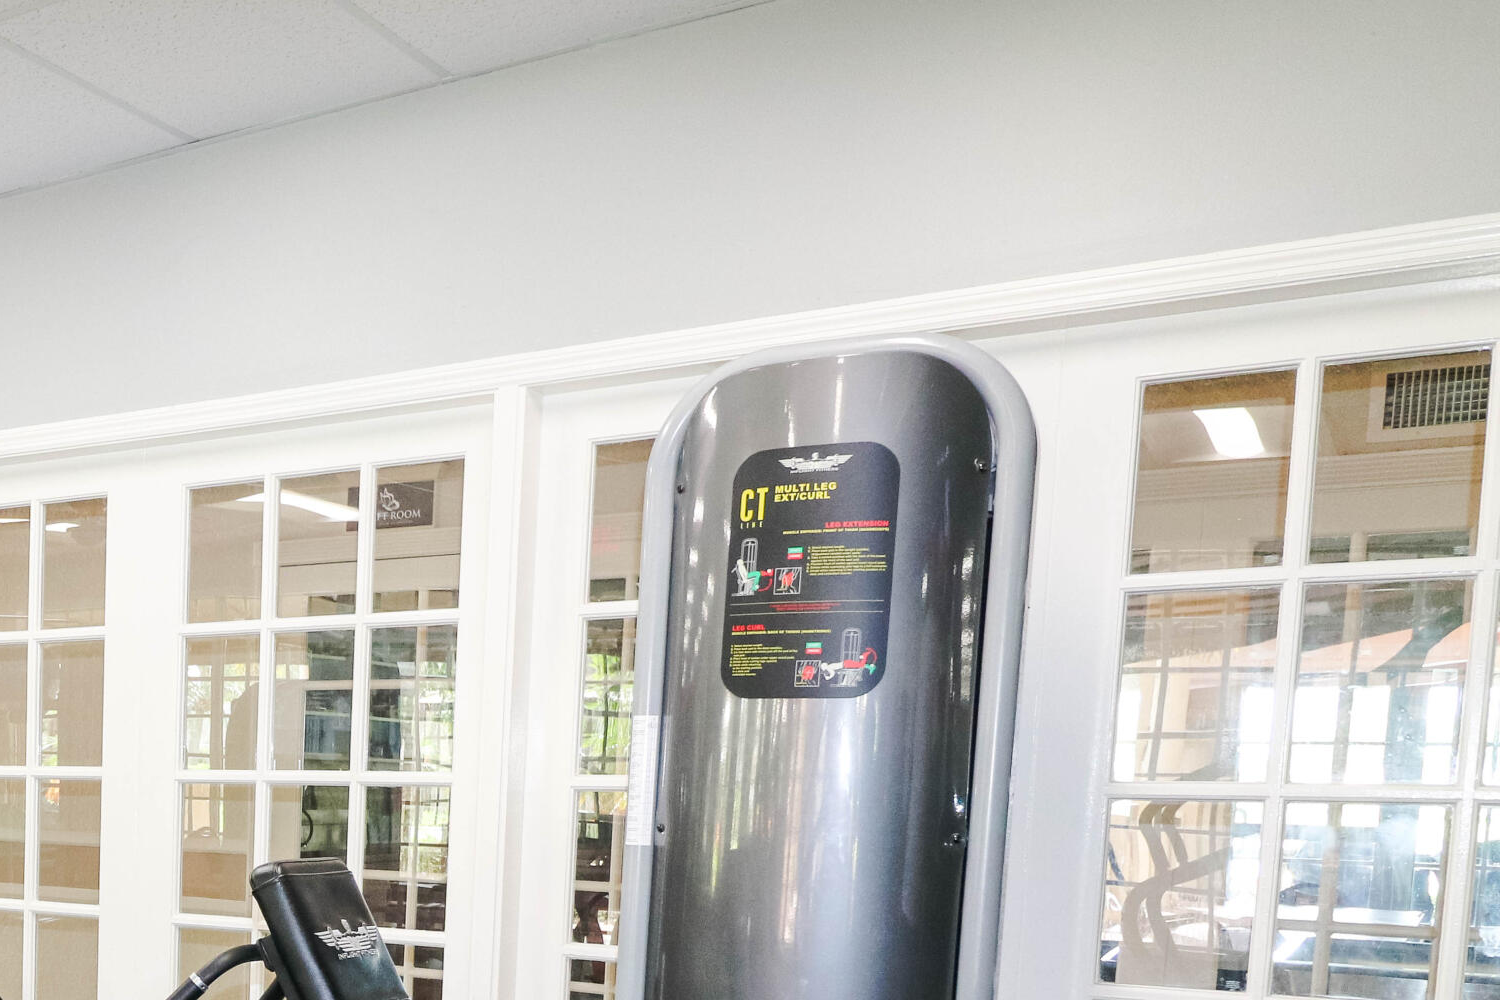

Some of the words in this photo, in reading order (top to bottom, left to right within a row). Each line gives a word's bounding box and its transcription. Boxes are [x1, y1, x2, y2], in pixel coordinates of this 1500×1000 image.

[775, 484, 811, 494] MULTI
[814, 481, 837, 491] LEG
[774, 491, 831, 503] EXT/CURL
[740, 487, 769, 521] CT
[390, 509, 421, 520] ROOM
[825, 521, 841, 529] LEG
[843, 520, 890, 528] EXTENSION
